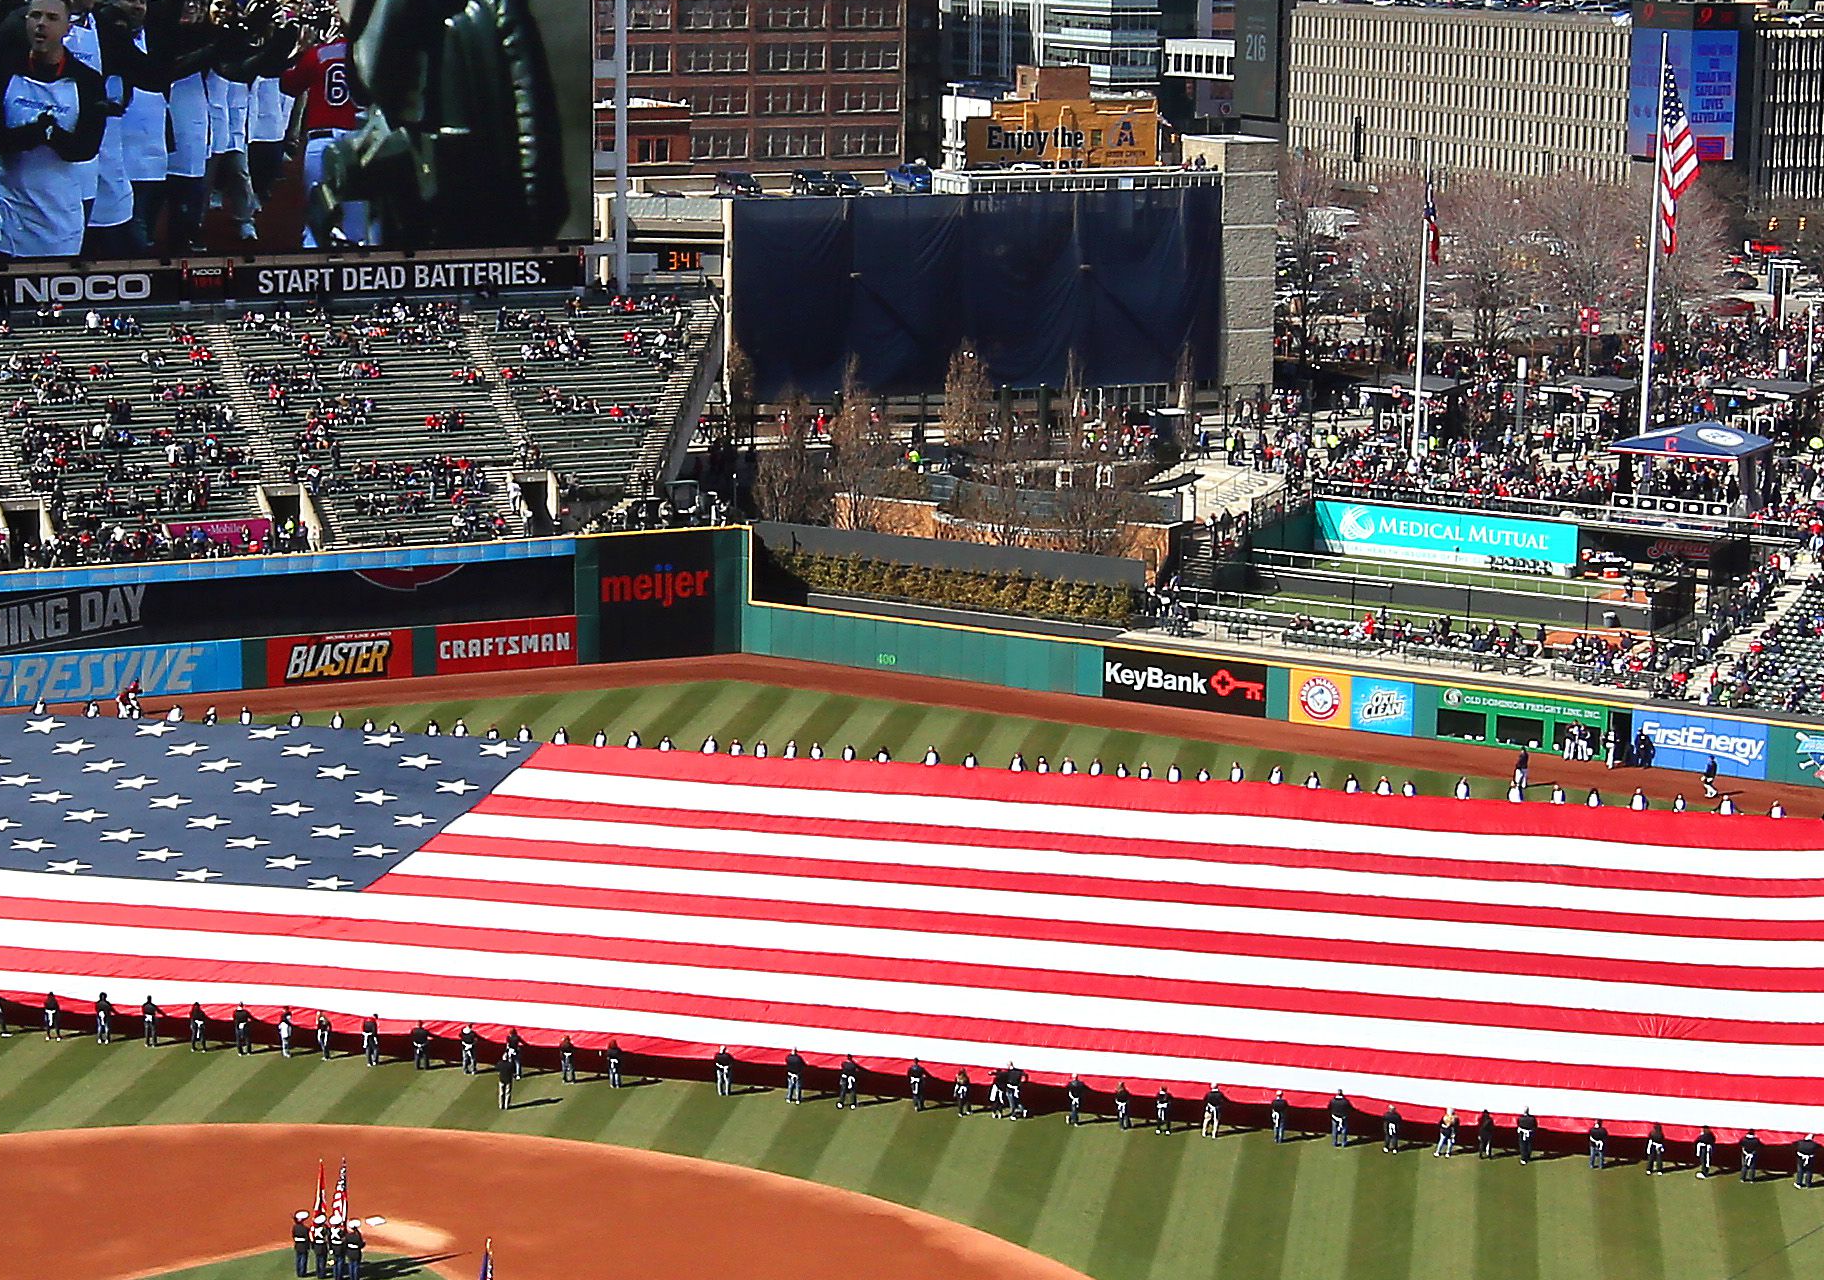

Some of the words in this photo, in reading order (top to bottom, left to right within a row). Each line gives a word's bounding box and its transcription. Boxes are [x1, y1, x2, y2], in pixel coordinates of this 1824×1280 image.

[1245, 33, 1266, 62] 216
[986, 124, 1049, 156] Enjoy
[1052, 125, 1084, 148] the
[191, 267, 222, 277] NOCO
[258, 268, 334, 295] START
[341, 265, 408, 292] DEAD
[414, 260, 549, 289] BATTERIES.
[14, 273, 151, 305] NOCO
[1378, 517, 1464, 542] MEDICAL
[1468, 525, 1549, 551] MUTUAL
[601, 564, 712, 608] meijer
[80, 585, 146, 632] DAY
[286, 640, 390, 680] BLASTER
[440, 632, 571, 660] CRAFTSMAN
[1105, 662, 1207, 696] KeyBank
[1363, 703, 1403, 718] CLEAN
[1371, 691, 1395, 706] OXI
[1464, 695, 1481, 705] OLD
[1482, 697, 1525, 709] DOMINION
[1526, 701, 1562, 713] FREIGHT
[1642, 721, 1764, 763] FirstEnergy
